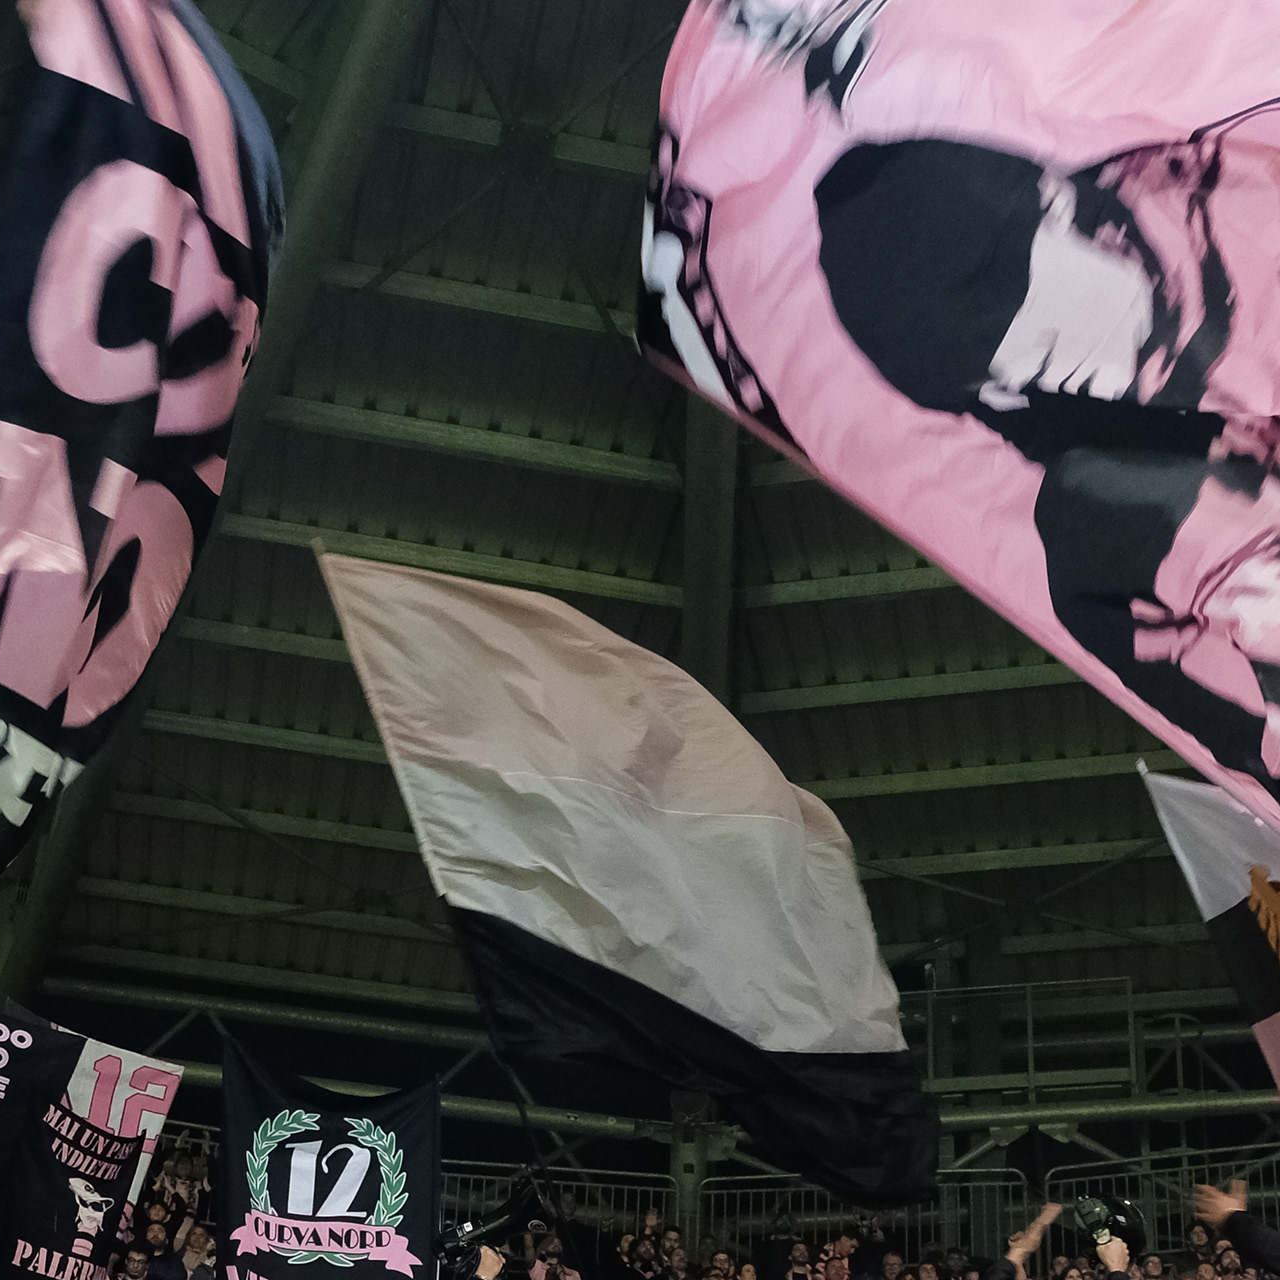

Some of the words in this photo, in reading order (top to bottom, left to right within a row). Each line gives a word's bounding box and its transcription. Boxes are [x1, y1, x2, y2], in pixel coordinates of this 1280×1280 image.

[82, 1054, 181, 1138] 12
[42, 1103, 81, 1141] MAI
[79, 1128, 110, 1156] UN
[285, 1139, 375, 1219] 12
[253, 1215, 322, 1247] CURVA
[328, 1226, 392, 1250] NORD
